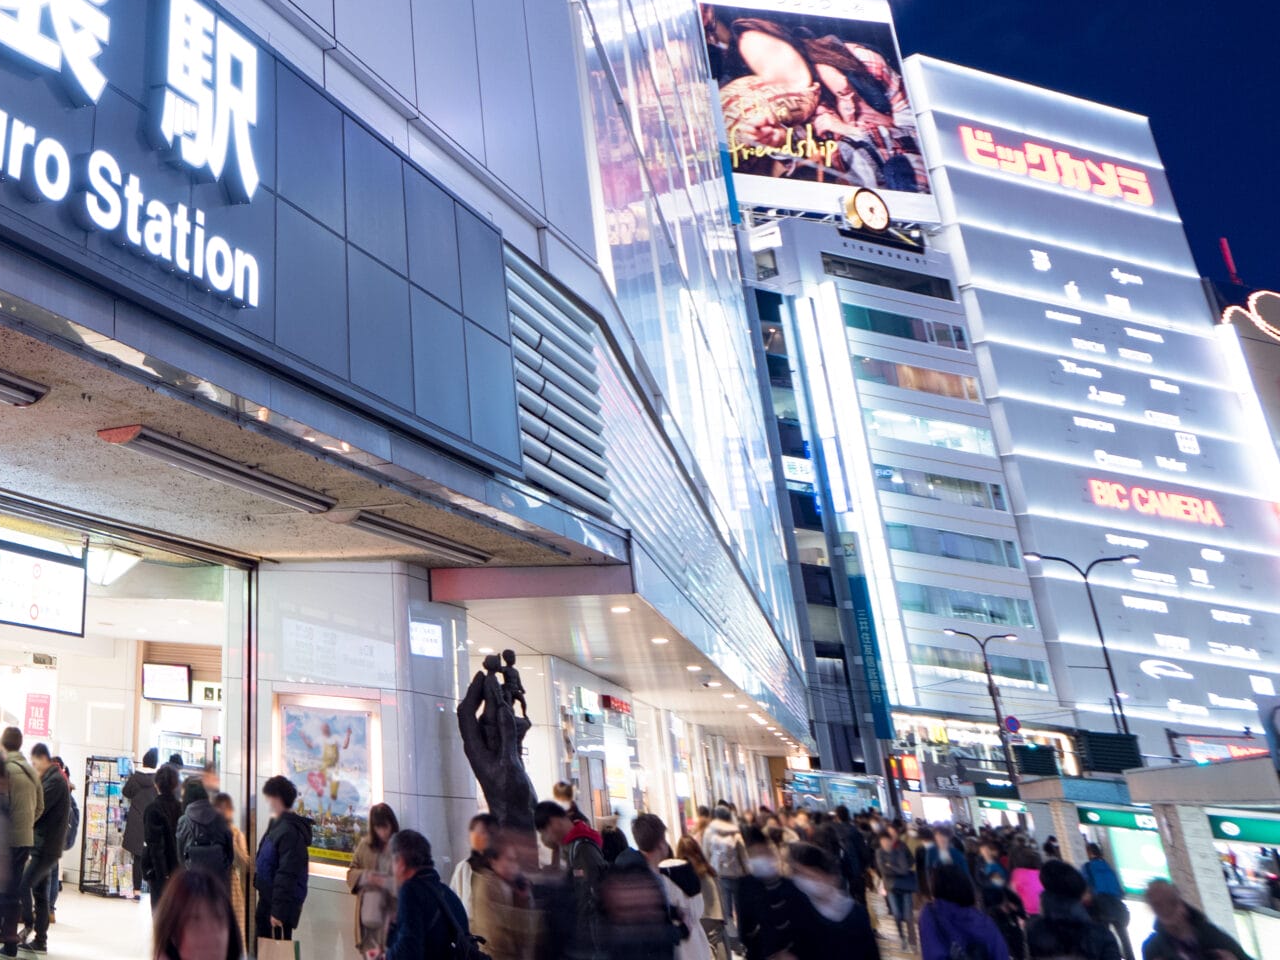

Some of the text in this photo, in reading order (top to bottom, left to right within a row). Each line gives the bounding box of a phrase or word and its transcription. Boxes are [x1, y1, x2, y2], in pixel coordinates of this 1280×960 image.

[729, 125, 838, 168] friendship
[958, 125, 1154, 206] ビックカメラ
[85, 144, 260, 308] Station
[1088, 478, 1225, 527] BIC CAMERA
[28, 717, 46, 730] FREE
[30, 705, 45, 718] TAX
